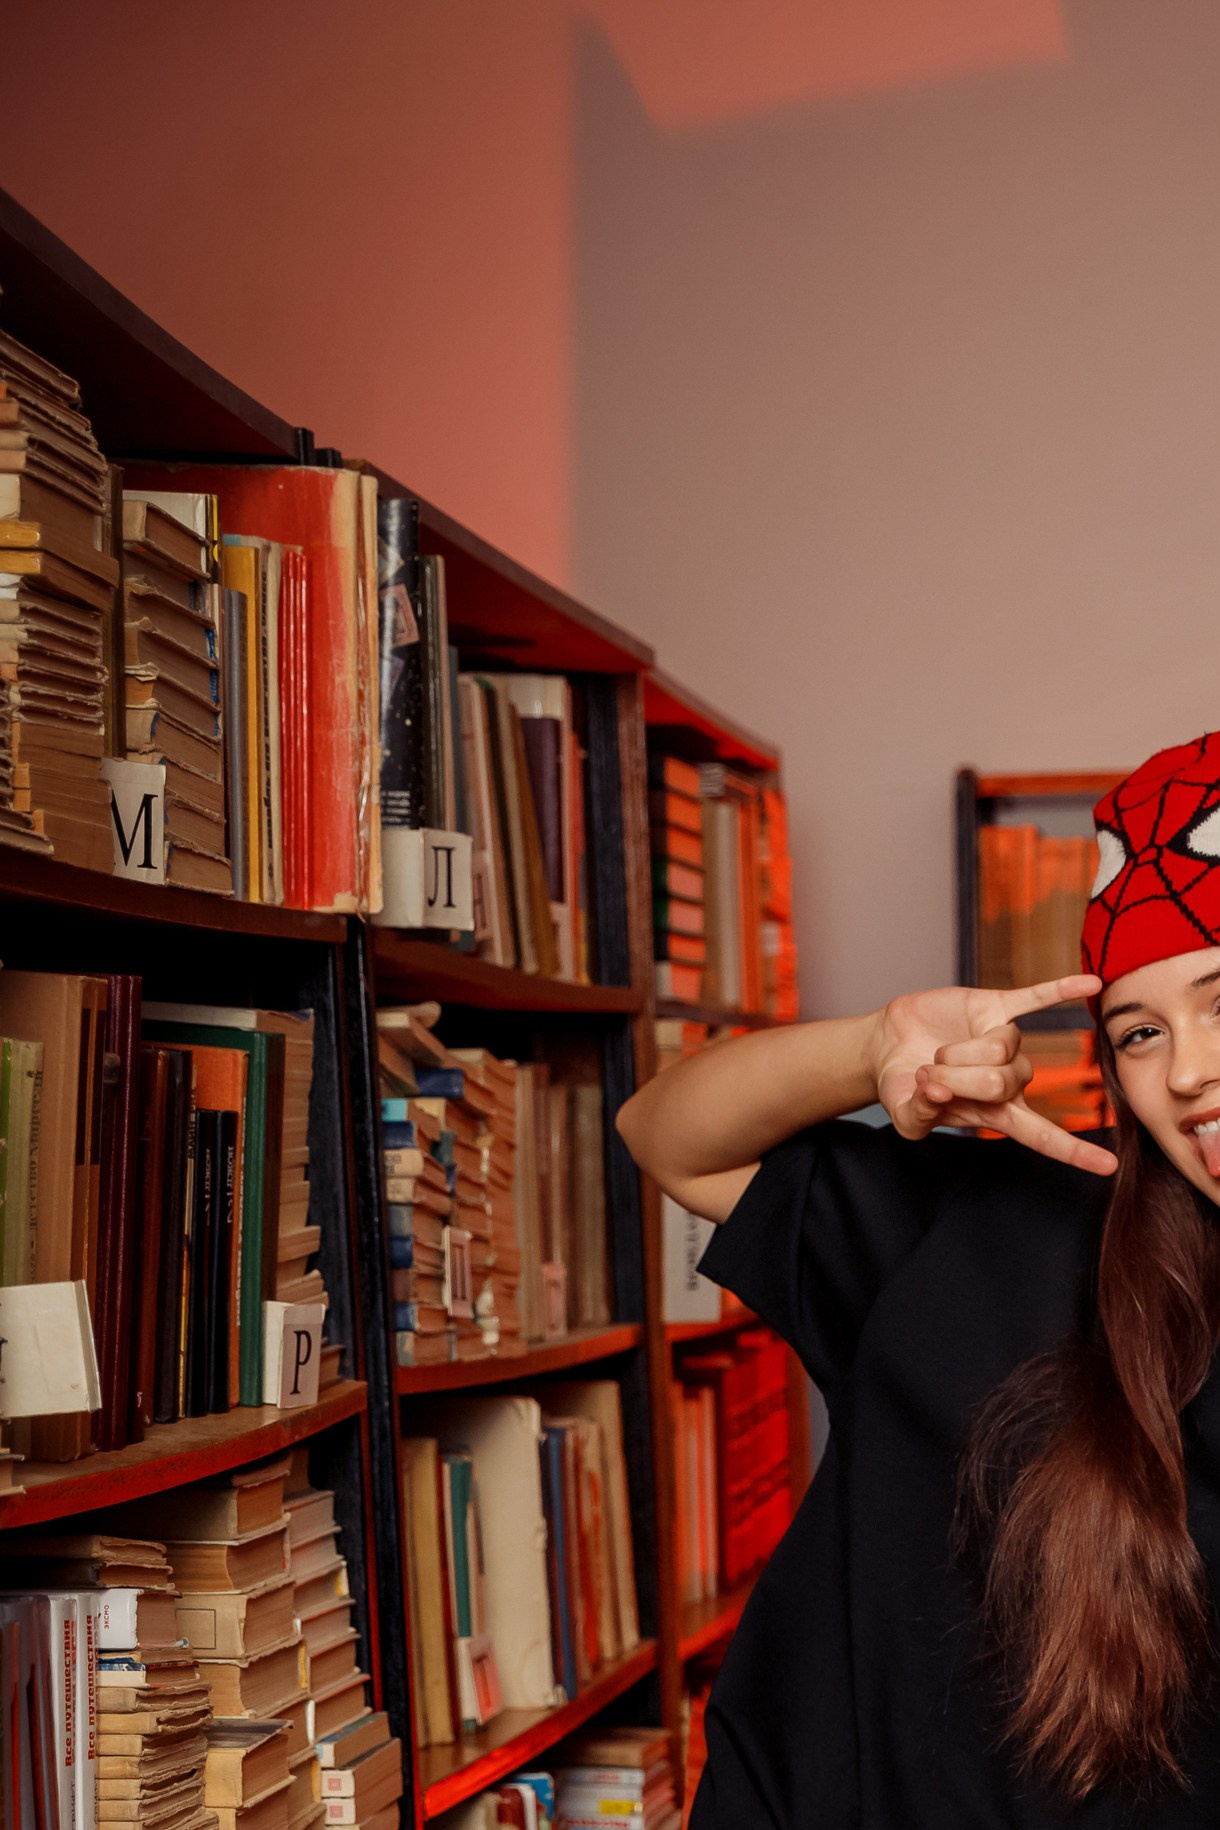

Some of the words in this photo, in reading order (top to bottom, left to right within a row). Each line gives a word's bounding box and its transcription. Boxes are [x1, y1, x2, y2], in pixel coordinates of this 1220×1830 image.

[111, 792, 159, 870] М
[427, 845, 457, 909] Л
[293, 1328, 313, 1395] Р
[103, 1603, 111, 1630] ЭКСМО
[63, 1618, 73, 1732] путешествия
[86, 1614, 95, 1727] путешествия
[65, 1737, 73, 1767] Все
[87, 1731, 95, 1761] Все
